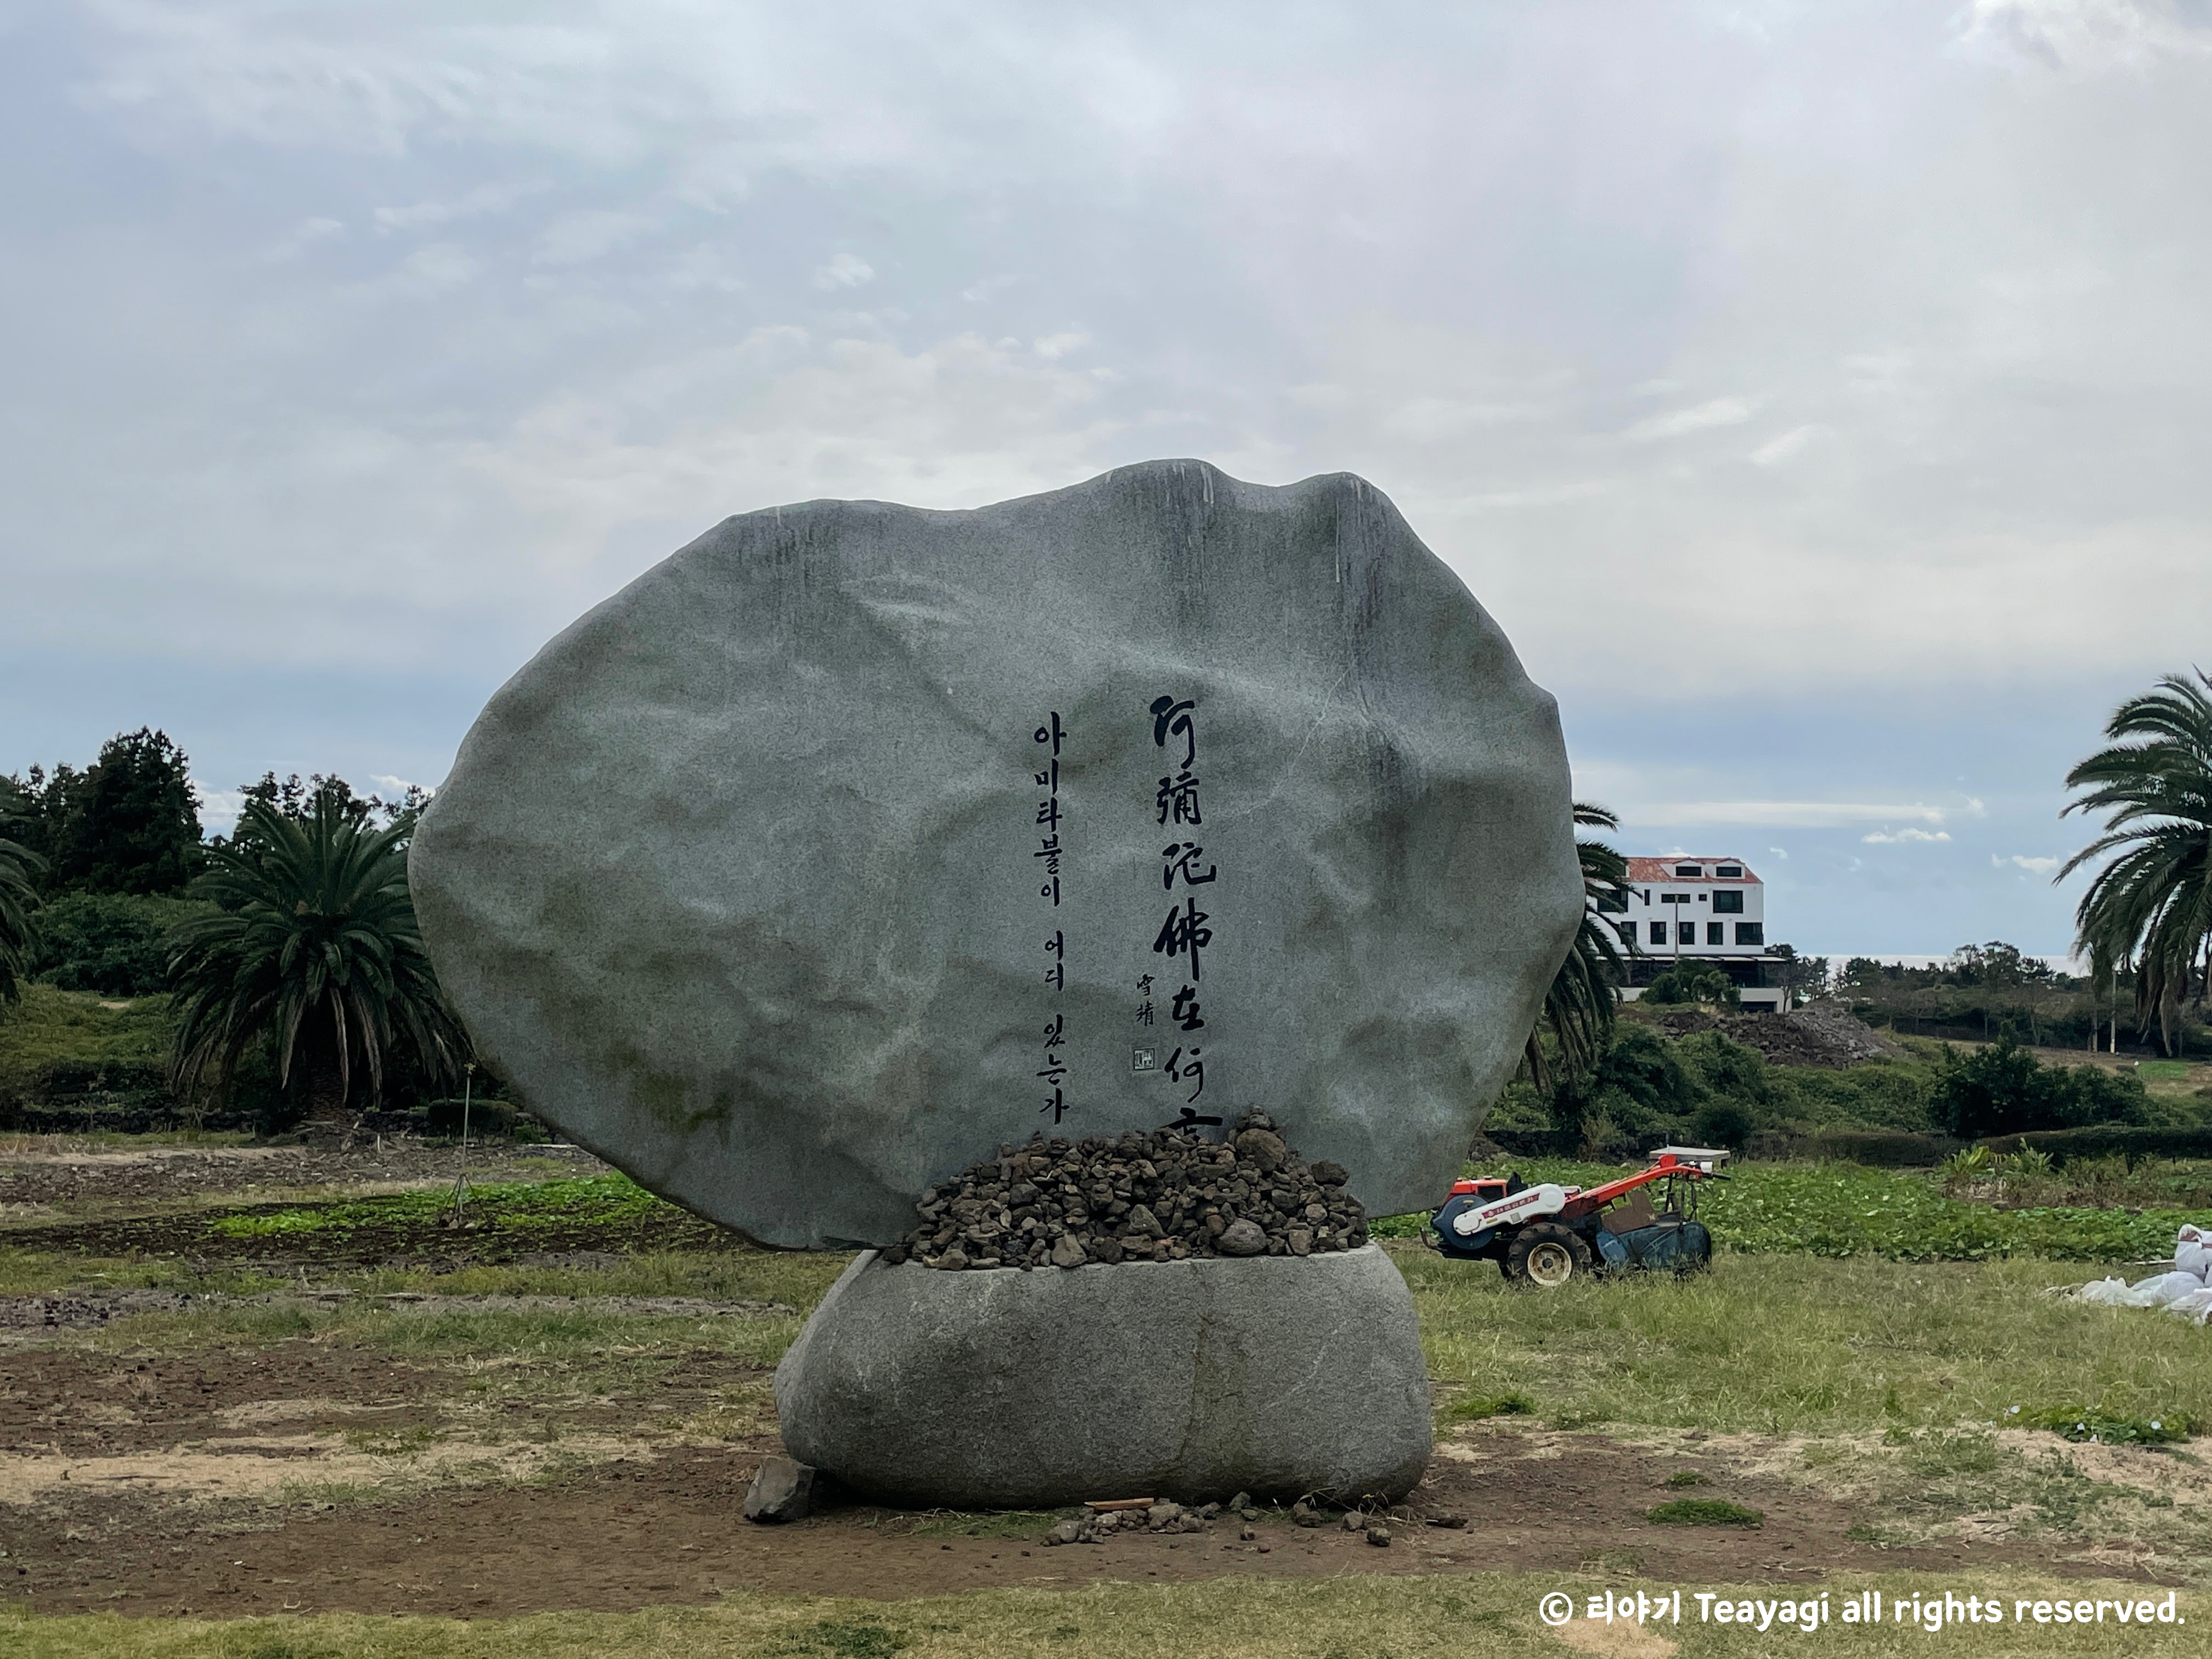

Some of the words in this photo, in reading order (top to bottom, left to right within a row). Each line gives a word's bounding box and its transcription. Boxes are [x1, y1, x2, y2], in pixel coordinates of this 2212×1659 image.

[1034, 712, 1067, 907] 아미타불이
[1044, 930, 1064, 991] 어디
[1036, 1014, 1070, 1125] 있는가
